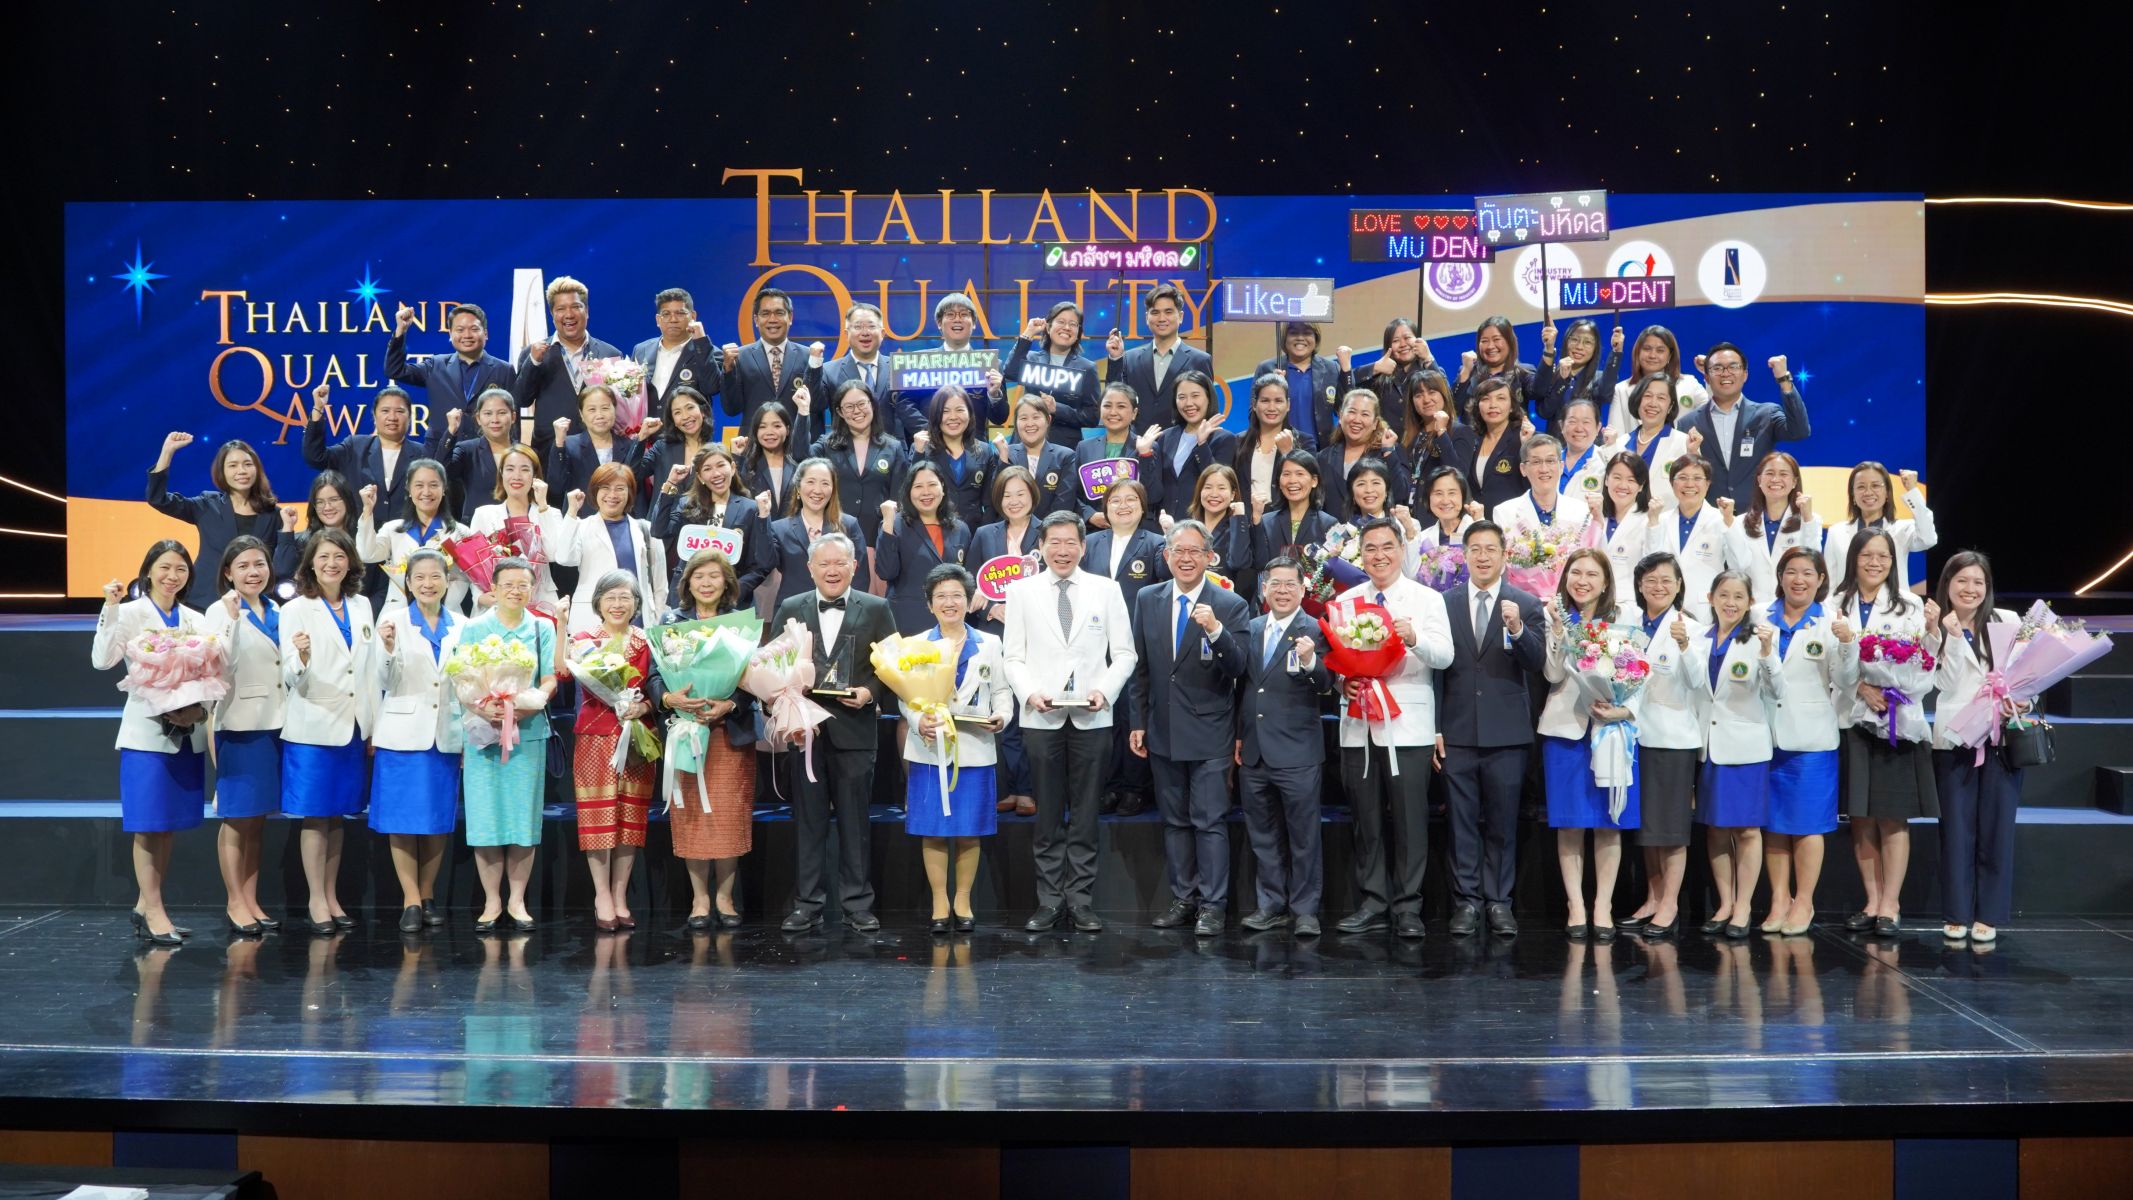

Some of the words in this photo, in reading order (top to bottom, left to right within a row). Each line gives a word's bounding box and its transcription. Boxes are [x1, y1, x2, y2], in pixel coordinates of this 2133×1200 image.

[722, 168, 1218, 266] THAILAND
[1353, 214, 1402, 232] LOVE
[1227, 283, 1285, 315] Like
[1563, 281, 1599, 305] MU
[1612, 280, 1672, 304] DENT
[892, 352, 996, 371] PHARMACY
[902, 369, 986, 388] MAHIDOL
[1021, 363, 1083, 392] MUPY
